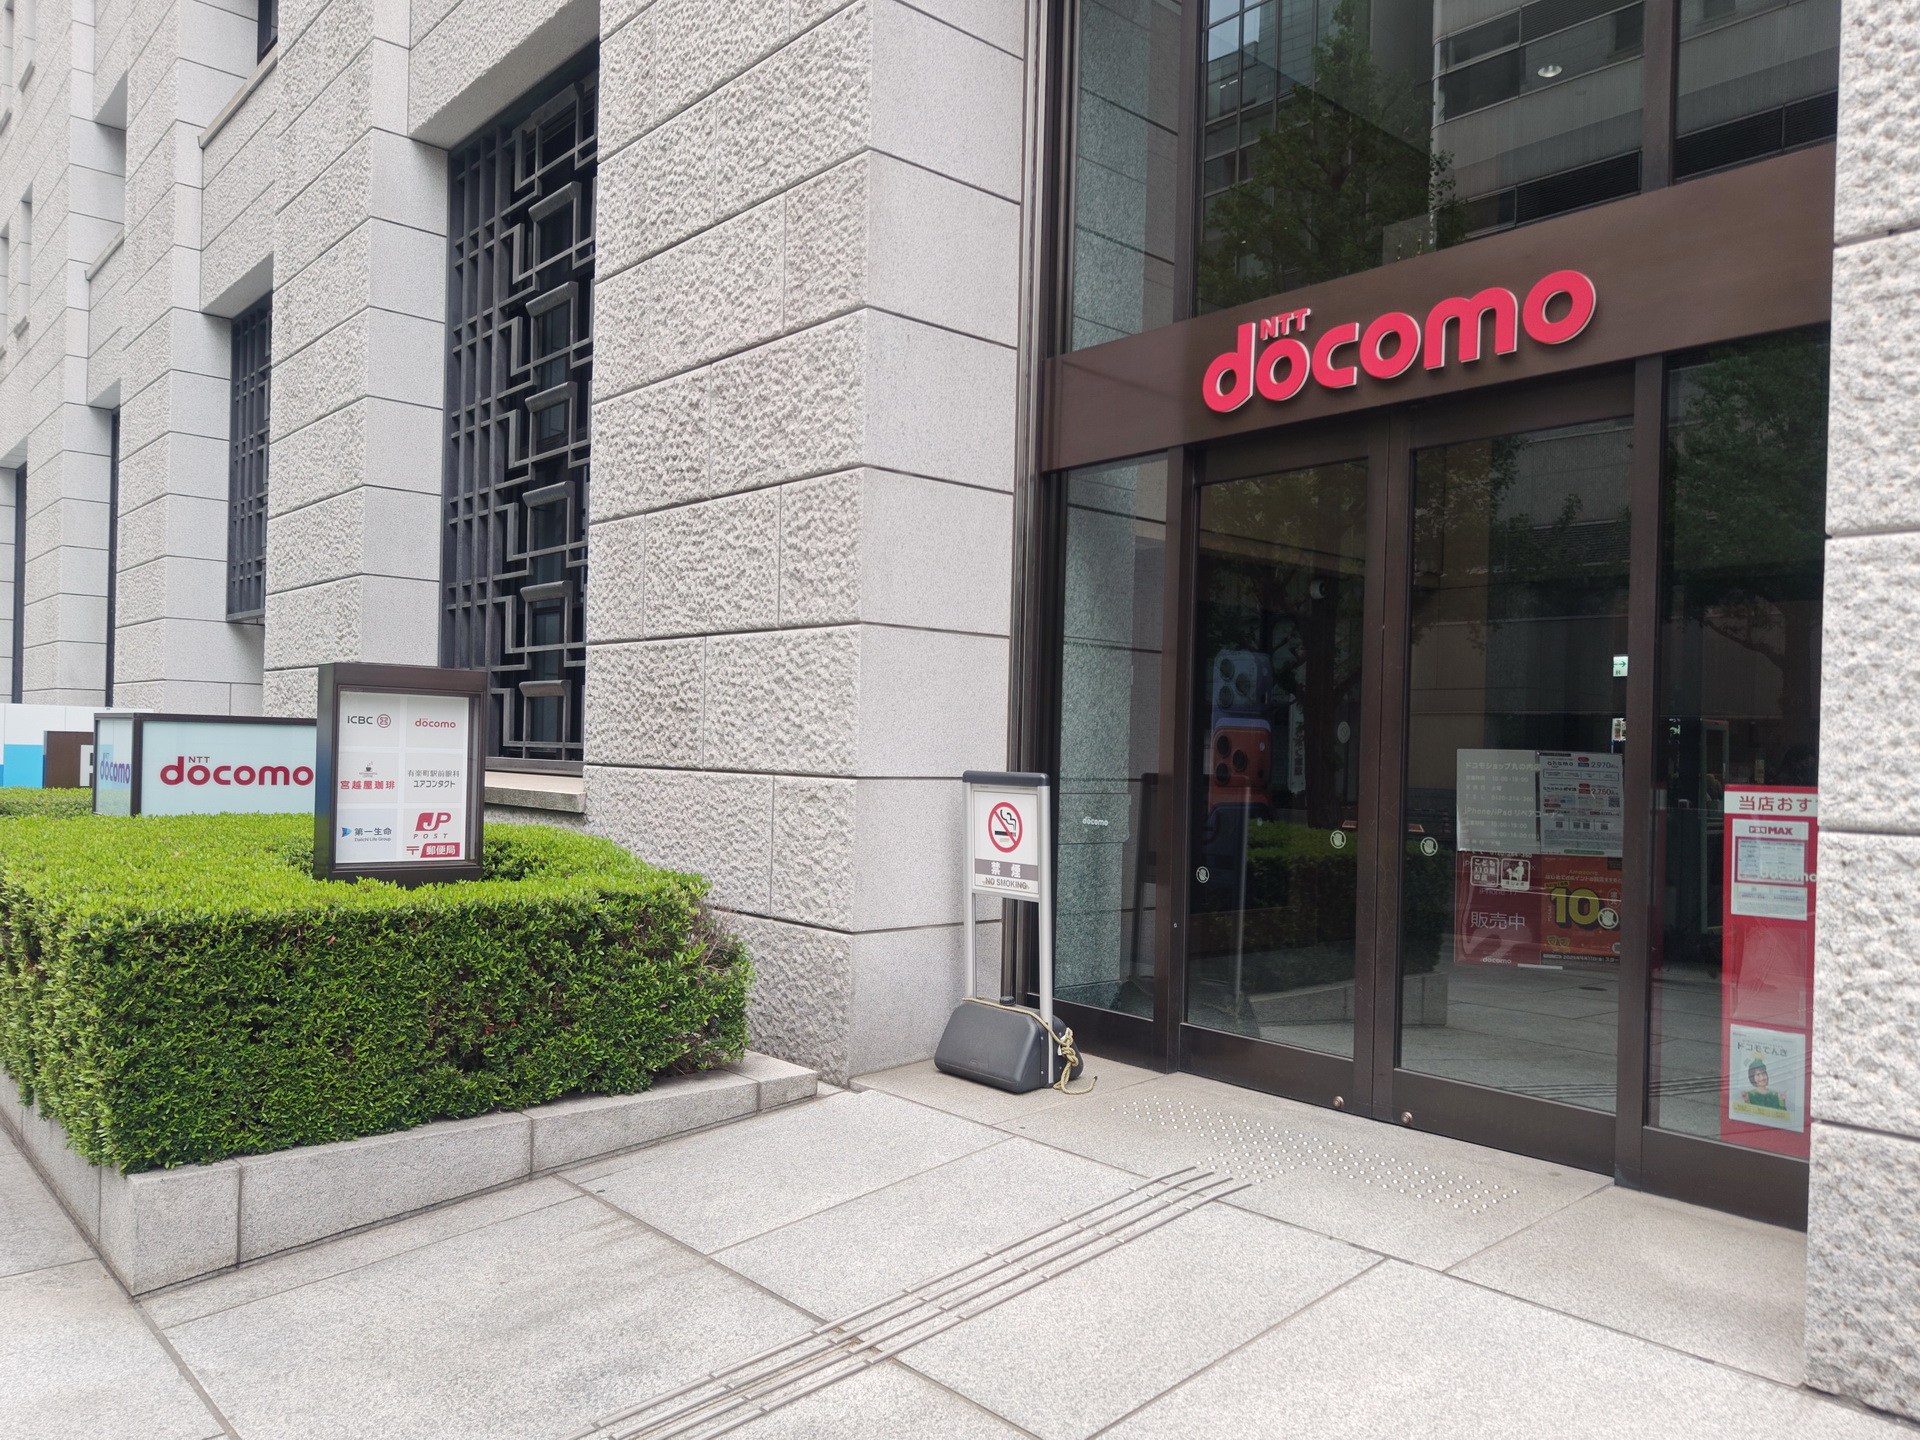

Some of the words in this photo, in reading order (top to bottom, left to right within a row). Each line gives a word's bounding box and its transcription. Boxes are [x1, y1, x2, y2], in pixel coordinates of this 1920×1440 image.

[1259, 307, 1312, 341] NTT
[1202, 269, 1597, 412] docomo
[347, 715, 374, 725] ICBC
[415, 718, 457, 728] docomo
[188, 756, 211, 764] NTT
[100, 753, 131, 784] docomo
[160, 756, 314, 786] docomo
[408, 769, 460, 778] 有楽町駅前眼科
[340, 780, 396, 790] 宮越屋珈琲
[413, 780, 456, 788] ユアコンタクト
[1739, 795, 1818, 812] 当店おす
[415, 812, 452, 831] JP
[1082, 817, 1109, 826] docomo
[354, 827, 393, 836] 第一生命
[426, 845, 456, 855] 郵便局
[991, 861, 1021, 879] 禁煙
[985, 877, 995, 886] NO
[996, 878, 1027, 890] SMOKING
[1551, 887, 1600, 925] 10
[1471, 911, 1526, 931] 販売中
[1482, 956, 1512, 964] docomo
